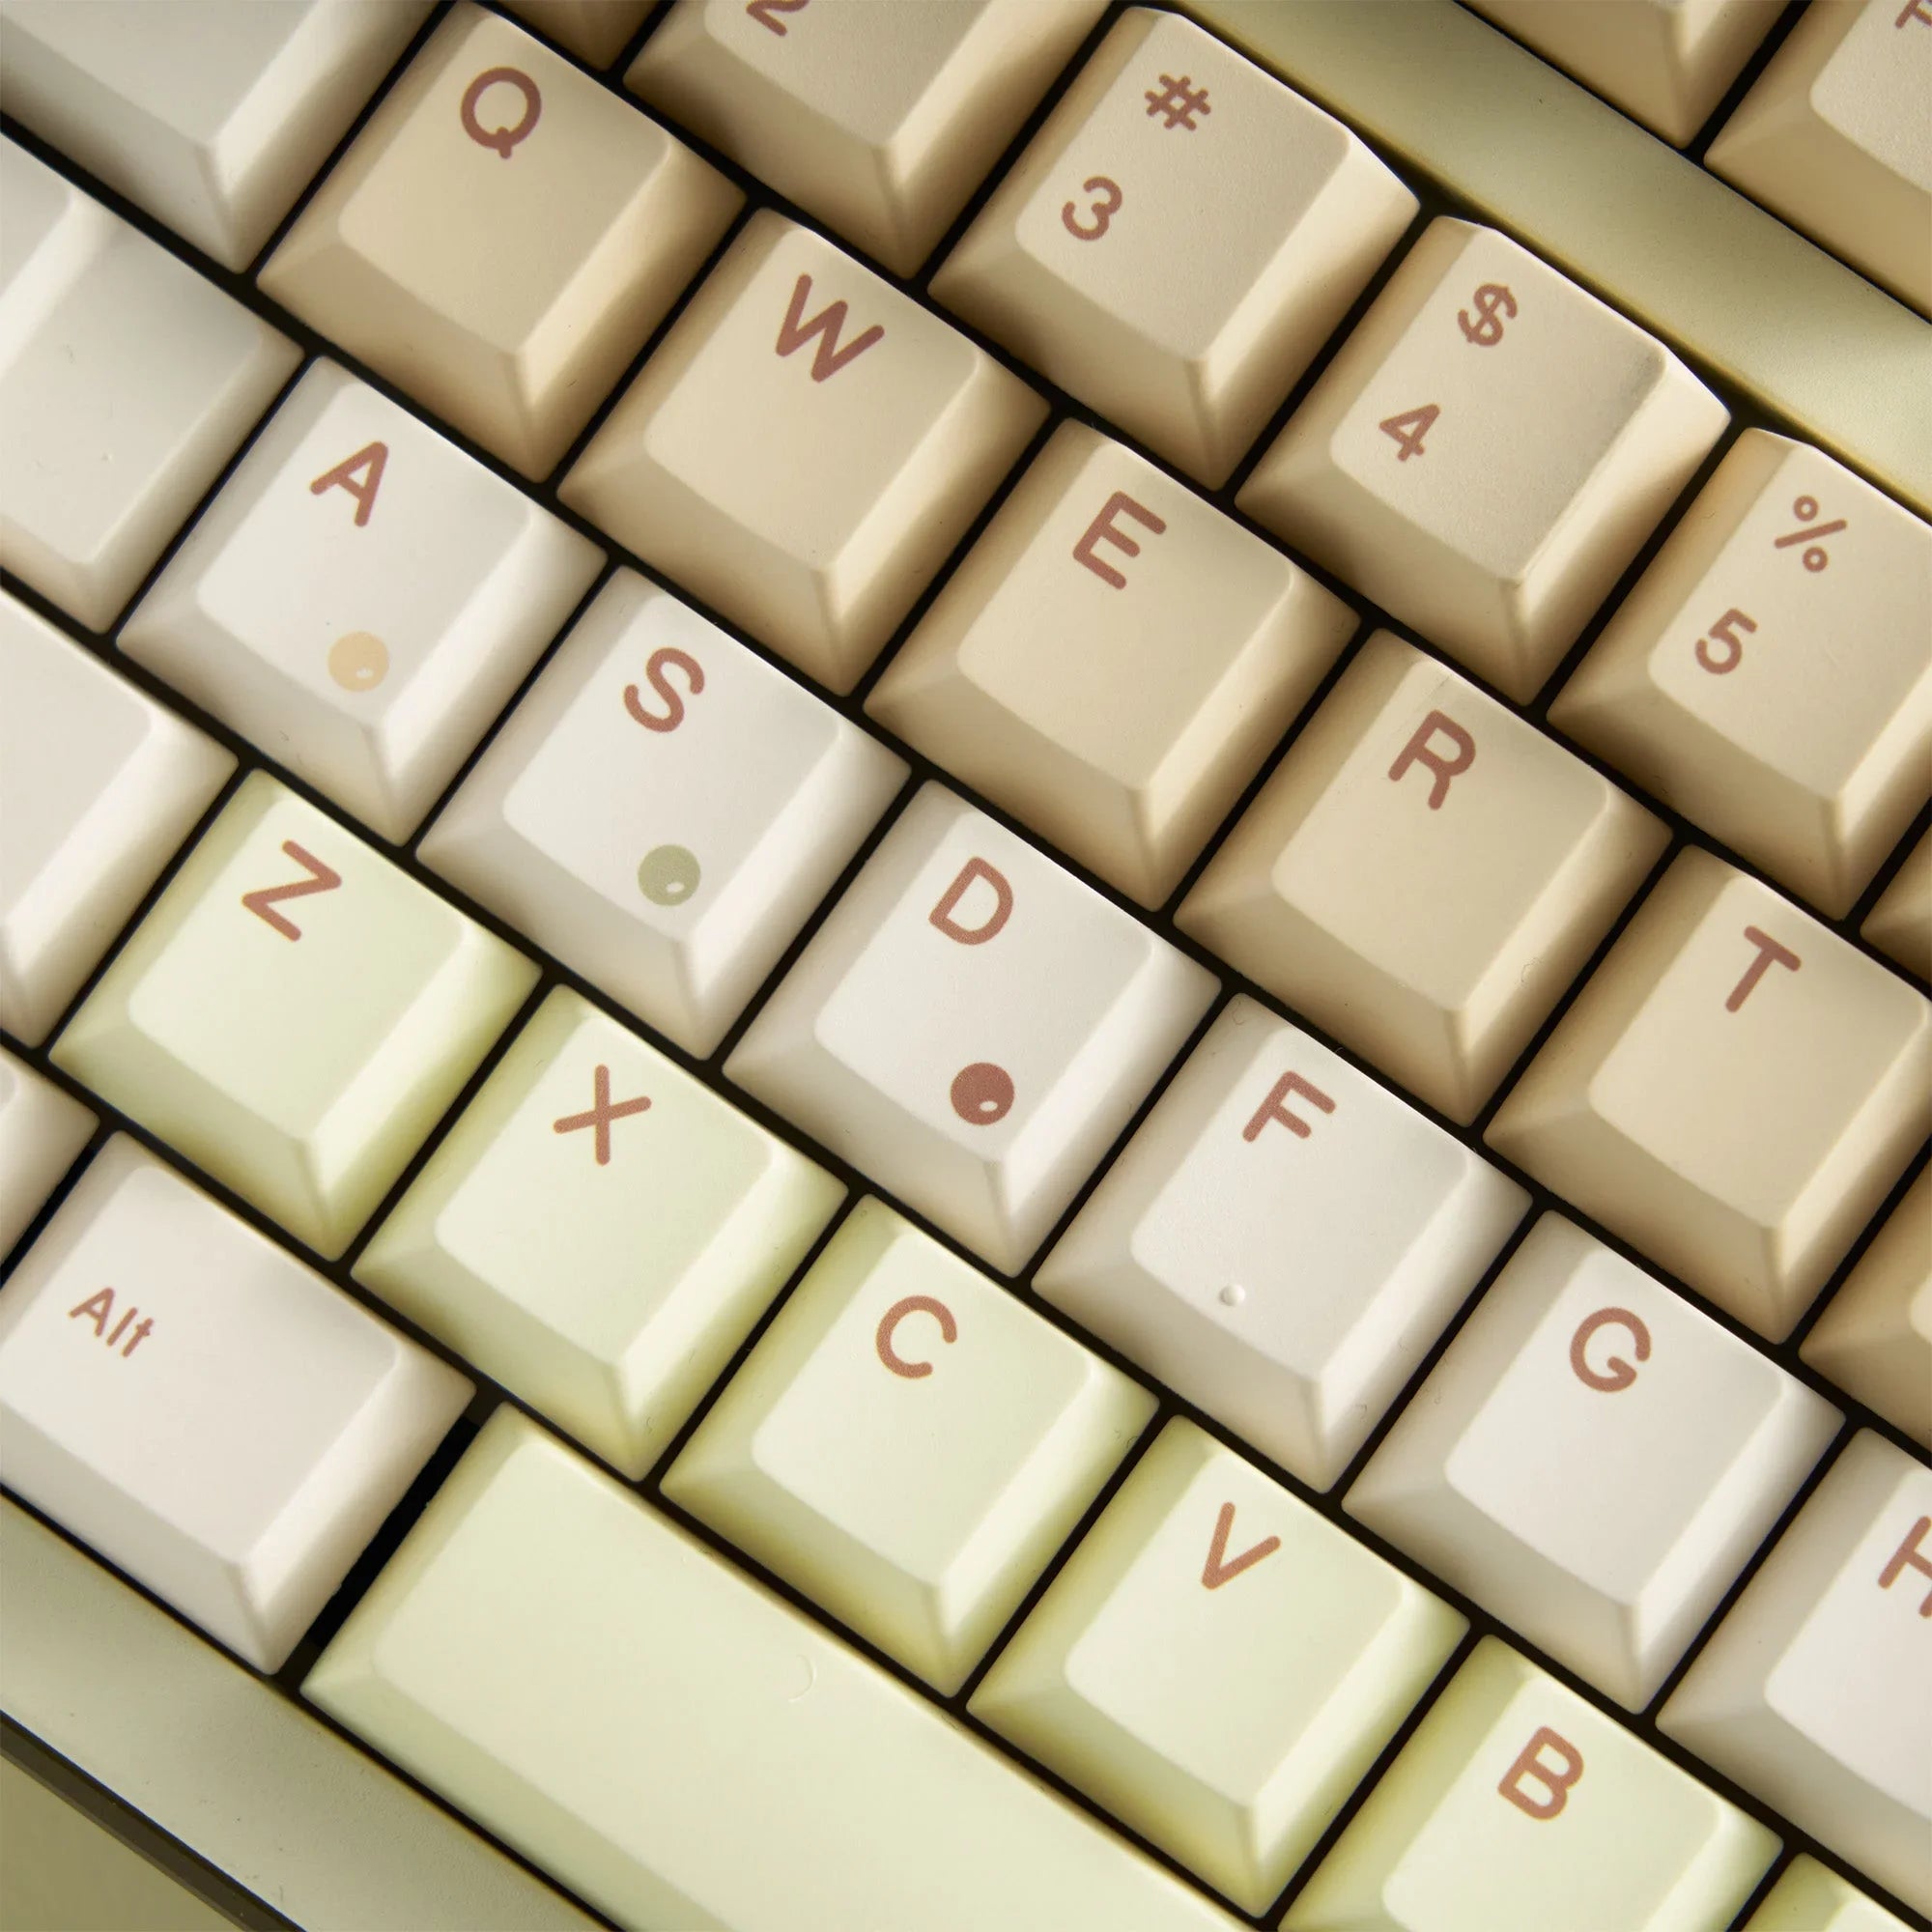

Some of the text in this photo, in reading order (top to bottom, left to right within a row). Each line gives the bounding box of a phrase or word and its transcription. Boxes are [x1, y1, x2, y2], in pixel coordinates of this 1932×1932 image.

[462, 69, 542, 159] Q
[1145, 77, 1210, 130] #
[1062, 179, 1122, 241] 3
[777, 275, 885, 383] W
[1459, 285, 1517, 346] $
[1379, 406, 1439, 462] 4
[310, 443, 388, 526] A
[1074, 493, 1165, 589] E
[1775, 497, 1845, 572] %
[1696, 611, 1756, 674] 5
[625, 649, 705, 732] S
[1389, 711, 1474, 810] R
[243, 840, 341, 942] Z
[929, 858, 1012, 945] D
[1726, 926, 1799, 1012] T
[554, 1065, 652, 1165] X
[1244, 1071, 1335, 1142] F
[70, 1288, 155, 1356] Alt
[877, 1296, 957, 1378] C
[1571, 1308, 1650, 1391] G
[1202, 1502, 1280, 1589] V
[1499, 1726, 1582, 1818] B
